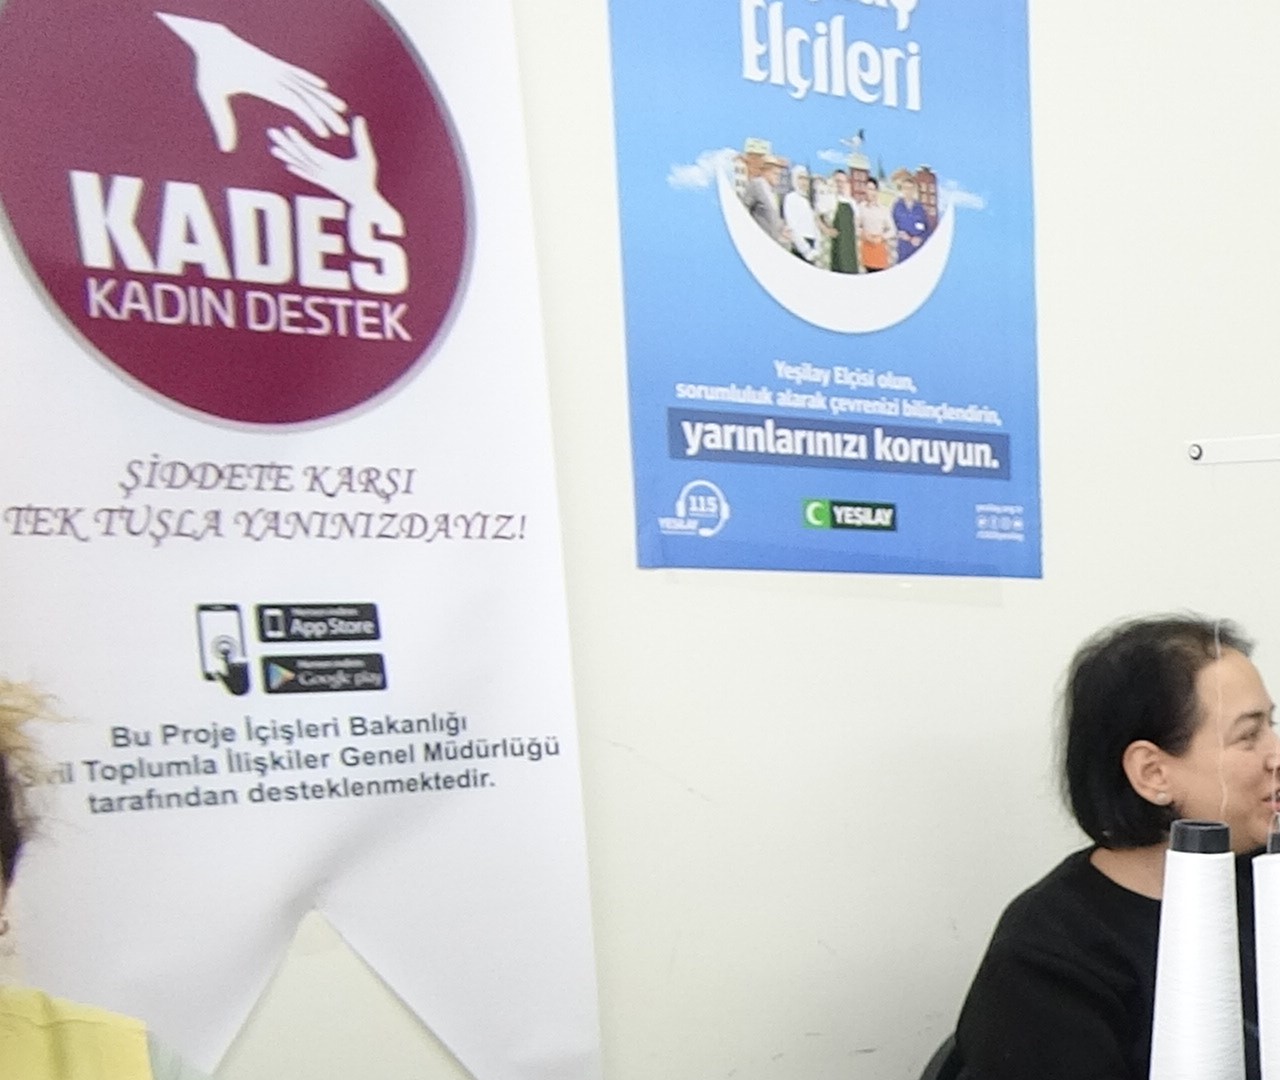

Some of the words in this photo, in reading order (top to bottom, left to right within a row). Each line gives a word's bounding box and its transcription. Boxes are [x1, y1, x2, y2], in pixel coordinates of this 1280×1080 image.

[740, 0, 921, 111] Elçileri
[69, 170, 409, 294] KADES
[86, 278, 236, 329] KADIN
[246, 291, 412, 341] DESTEK
[773, 360, 832, 387] Yeşilay
[833, 366, 875, 390] Elçisi
[675, 383, 773, 406] sorumluluk
[776, 388, 827, 410] alarak
[829, 397, 900, 416] çevrenizi
[680, 418, 868, 460] yarınlarınızı
[873, 427, 1000, 473] koruyun.
[118, 453, 295, 499] ŞİDDETE
[302, 464, 416, 504] KARŞI
[3, 503, 90, 542] TEK
[94, 504, 223, 547] TUŞLA
[233, 508, 527, 543] YANINIZDAYIZ!
[689, 495, 717, 513] 115
[290, 618, 328, 639] App
[328, 617, 375, 635] Store
[111, 726, 151, 748] Bu
[161, 722, 236, 749] Proje
[244, 715, 340, 746] İçişleri
[349, 711, 468, 736] Bakanlığı
[82, 755, 217, 785] Toplumla
[227, 748, 330, 776] İlişkiler
[340, 745, 415, 767] Genel
[424, 736, 560, 762] Müdürlüğü
[89, 786, 238, 815] tarafından
[248, 768, 496, 803] desteklenmektedir.
